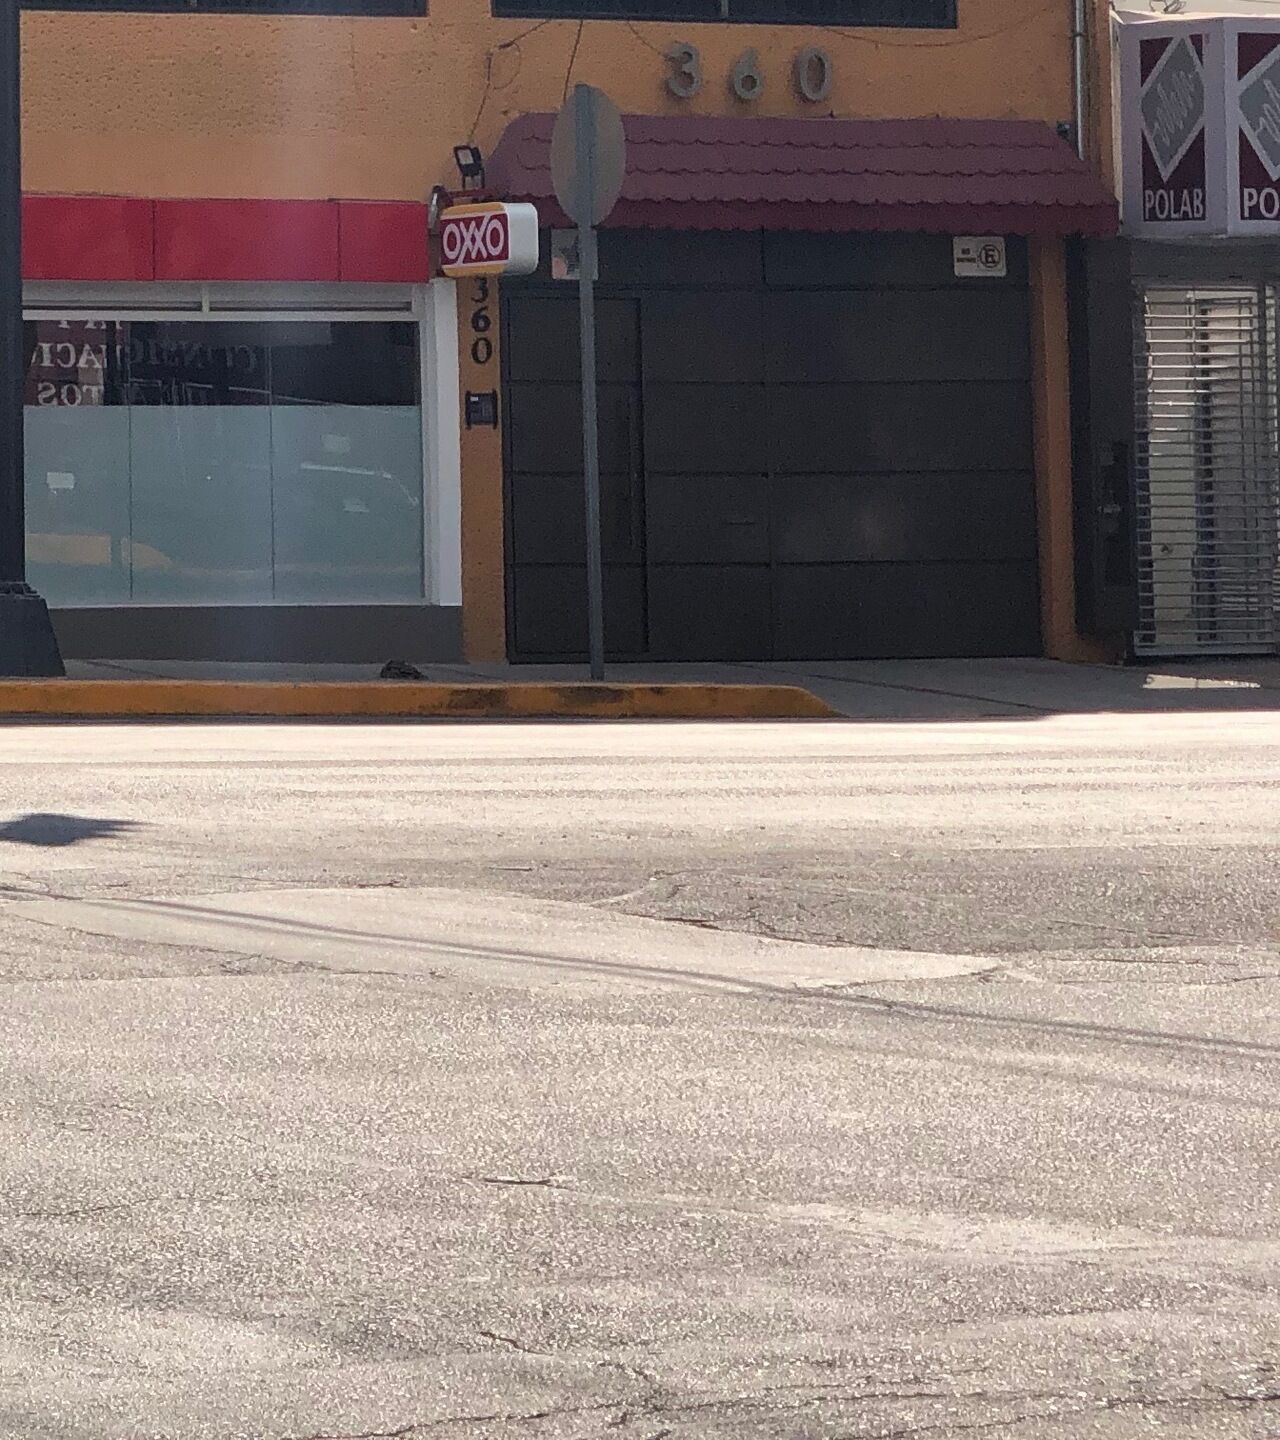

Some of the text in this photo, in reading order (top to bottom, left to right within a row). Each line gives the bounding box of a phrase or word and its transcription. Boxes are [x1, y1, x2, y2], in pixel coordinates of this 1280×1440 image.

[665, 41, 832, 101] 360
[1144, 188, 1204, 220] POLAB
[443, 215, 505, 264] OXXO
